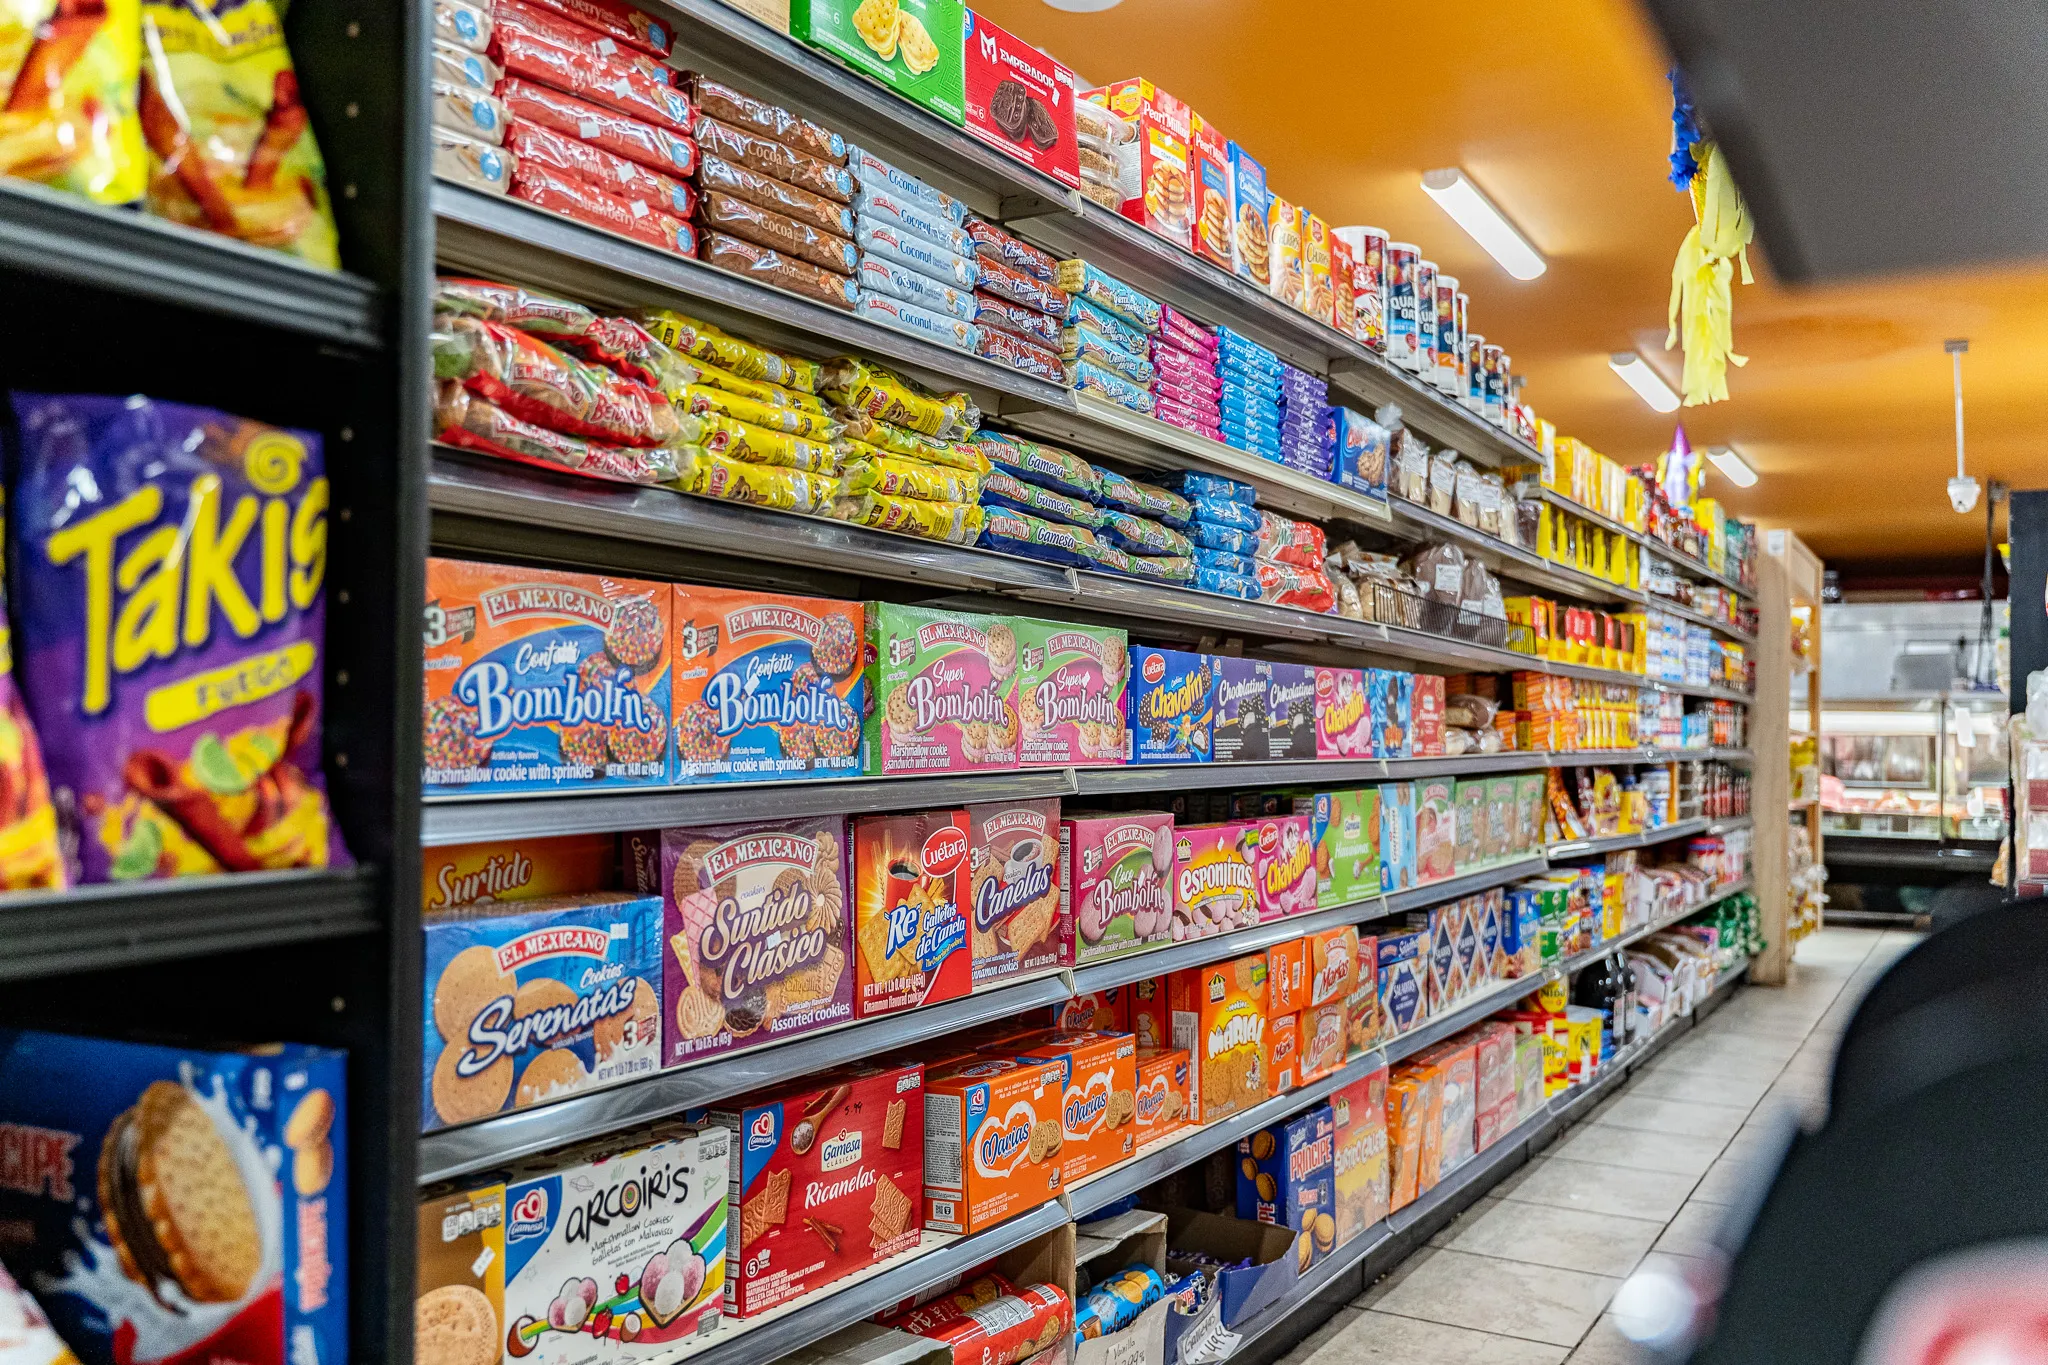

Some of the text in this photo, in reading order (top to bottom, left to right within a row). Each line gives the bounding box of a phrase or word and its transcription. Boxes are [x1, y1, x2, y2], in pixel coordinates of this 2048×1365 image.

[833, 12, 840, 25] 6
[1000, 48, 1055, 88] EMPERADOR
[978, 106, 985, 119] 6
[748, 141, 783, 167] Cocoa
[889, 169, 920, 196] Coconut
[760, 214, 793, 240] Cocoa
[900, 240, 932, 264] Coconut
[899, 308, 932, 330] Coconut
[1027, 453, 1065, 478] Gamesa
[1036, 492, 1073, 515] Gamesa
[1037, 527, 1075, 550] Gamesa
[47, 431, 330, 713] Takis
[491, 589, 612, 624] EL MEXICANO
[424, 607, 446, 646] 3
[732, 610, 820, 638] EL MEXICANO
[922, 623, 986, 648] EL MEXICANO
[683, 626, 698, 658] 3
[889, 639, 901, 668] 3
[1050, 633, 1102, 656] EL MEXICANO
[747, 653, 794, 680] Confetti
[1022, 647, 1032, 672] 3
[195, 653, 297, 711] FUEGO
[933, 659, 966, 688] Super
[1219, 678, 1267, 707] Chocolatines
[929, 744, 948, 757] cookie
[493, 765, 528, 782] cookie
[528, 763, 551, 781] with
[550, 761, 594, 784] sprinkles
[681, 756, 806, 776] Marshmallow cookie with sprinkles
[915, 758, 928, 770] with
[928, 757, 950, 770] coconut
[987, 812, 1044, 835] EL MEXICANO
[1107, 828, 1153, 849] EL MEXICANO
[711, 839, 814, 875] EL MEXICANO
[922, 838, 967, 868] Cuétara
[970, 847, 979, 869] 3
[1083, 848, 1092, 874] 3
[431, 850, 532, 909] Surtido
[1114, 863, 1134, 890] Coco
[1180, 855, 1254, 903] esponjitas
[976, 864, 1051, 926] Canelas
[701, 881, 810, 962] Surtido
[923, 902, 957, 932] Galletas
[501, 929, 607, 967] EL MEXICANO
[917, 934, 931, 960] de
[931, 916, 966, 951] Canela
[580, 963, 625, 990] Cookies
[998, 960, 1019, 974] cookies
[864, 983, 874, 998] NET
[874, 981, 884, 995] WT.
[863, 998, 889, 1014] Cinnamon
[889, 993, 907, 1009] flavored
[456, 977, 638, 1076] Serenatas
[770, 1001, 851, 1034] Assorted cookies
[622, 1019, 639, 1051] 3
[750, 1135, 772, 1146] Gamesa
[823, 1137, 861, 1162] Gamesa
[1290, 1133, 1332, 1182] PRINCIPE
[973, 1203, 1008, 1225] COOKIES GALLETAS
[511, 1221, 544, 1237] Gamesa
[624, 1237, 636, 1249] con
[746, 1268, 787, 1290] CINNAMON COOKIES
[748, 1262, 756, 1276] 5
[746, 1281, 772, 1297] NATURALLY
[746, 1283, 791, 1305] GALLETA CON CANELA
[746, 1301, 763, 1313] SABOR
[762, 1294, 781, 1309] NATURAL
